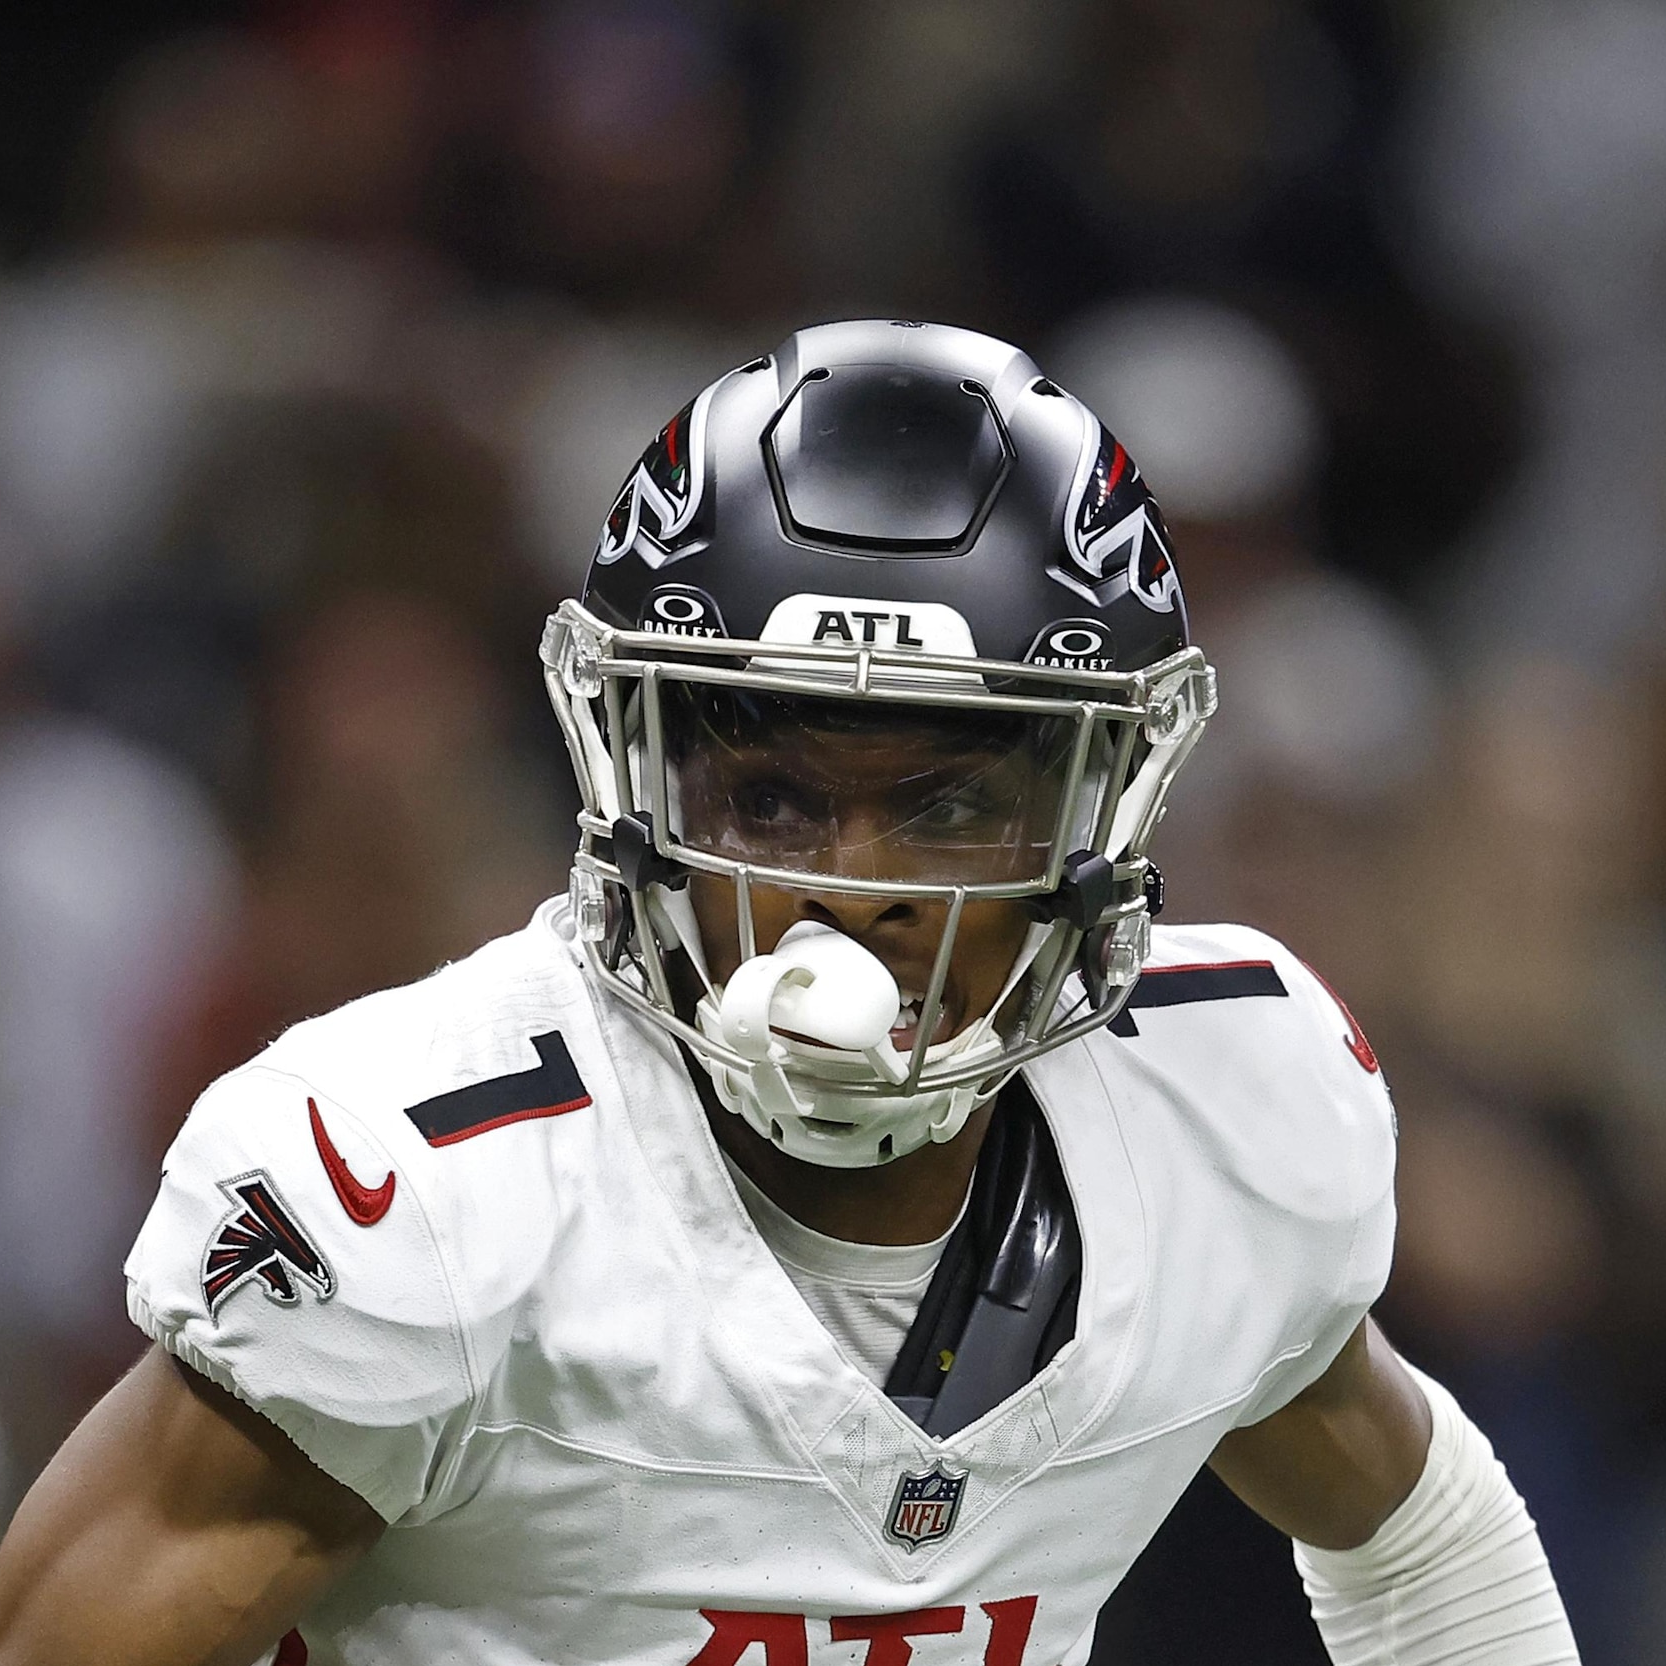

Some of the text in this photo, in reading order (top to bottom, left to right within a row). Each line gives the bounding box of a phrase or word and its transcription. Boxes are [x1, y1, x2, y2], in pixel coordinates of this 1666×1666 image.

[644, 619, 716, 639] OAKLEY
[813, 611, 923, 647] ATL
[1034, 656, 1110, 671] OAKLEY
[403, 1029, 594, 1149] 1
[897, 1503, 946, 1537] NFL
